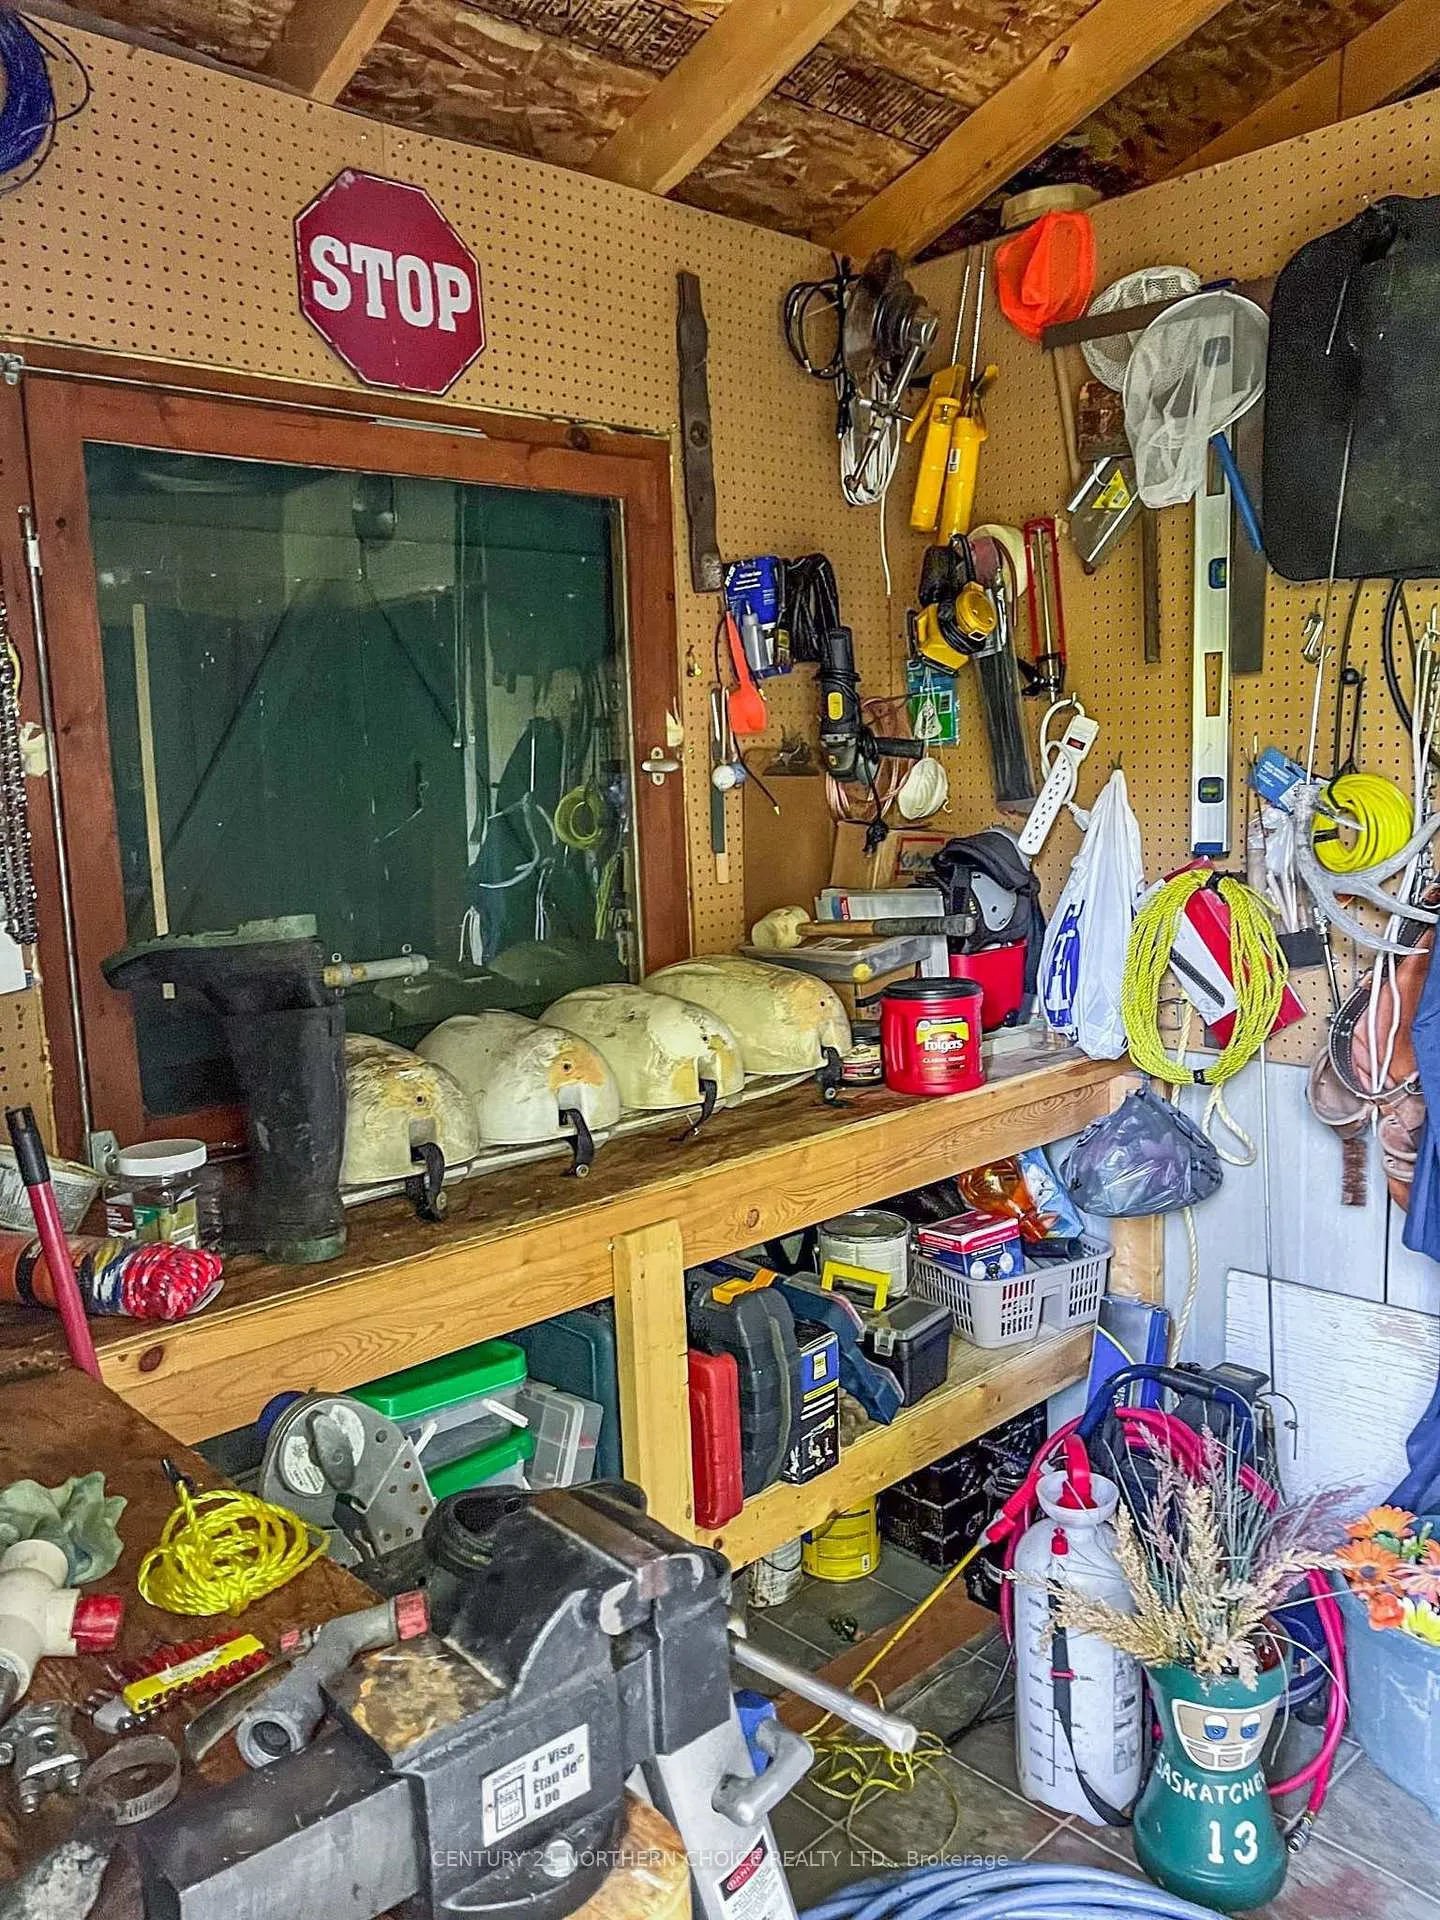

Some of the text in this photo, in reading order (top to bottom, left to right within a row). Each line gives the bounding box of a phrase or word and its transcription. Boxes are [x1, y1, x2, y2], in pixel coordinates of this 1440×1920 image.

[310, 235, 472, 332] STOP
[924, 1036, 964, 1054] Folgers
[548, 1743, 575, 1765] Vise
[562, 1761, 577, 1778] de
[1156, 1752, 1266, 1804] SASKATCHE
[1207, 1819, 1258, 1865] 13
